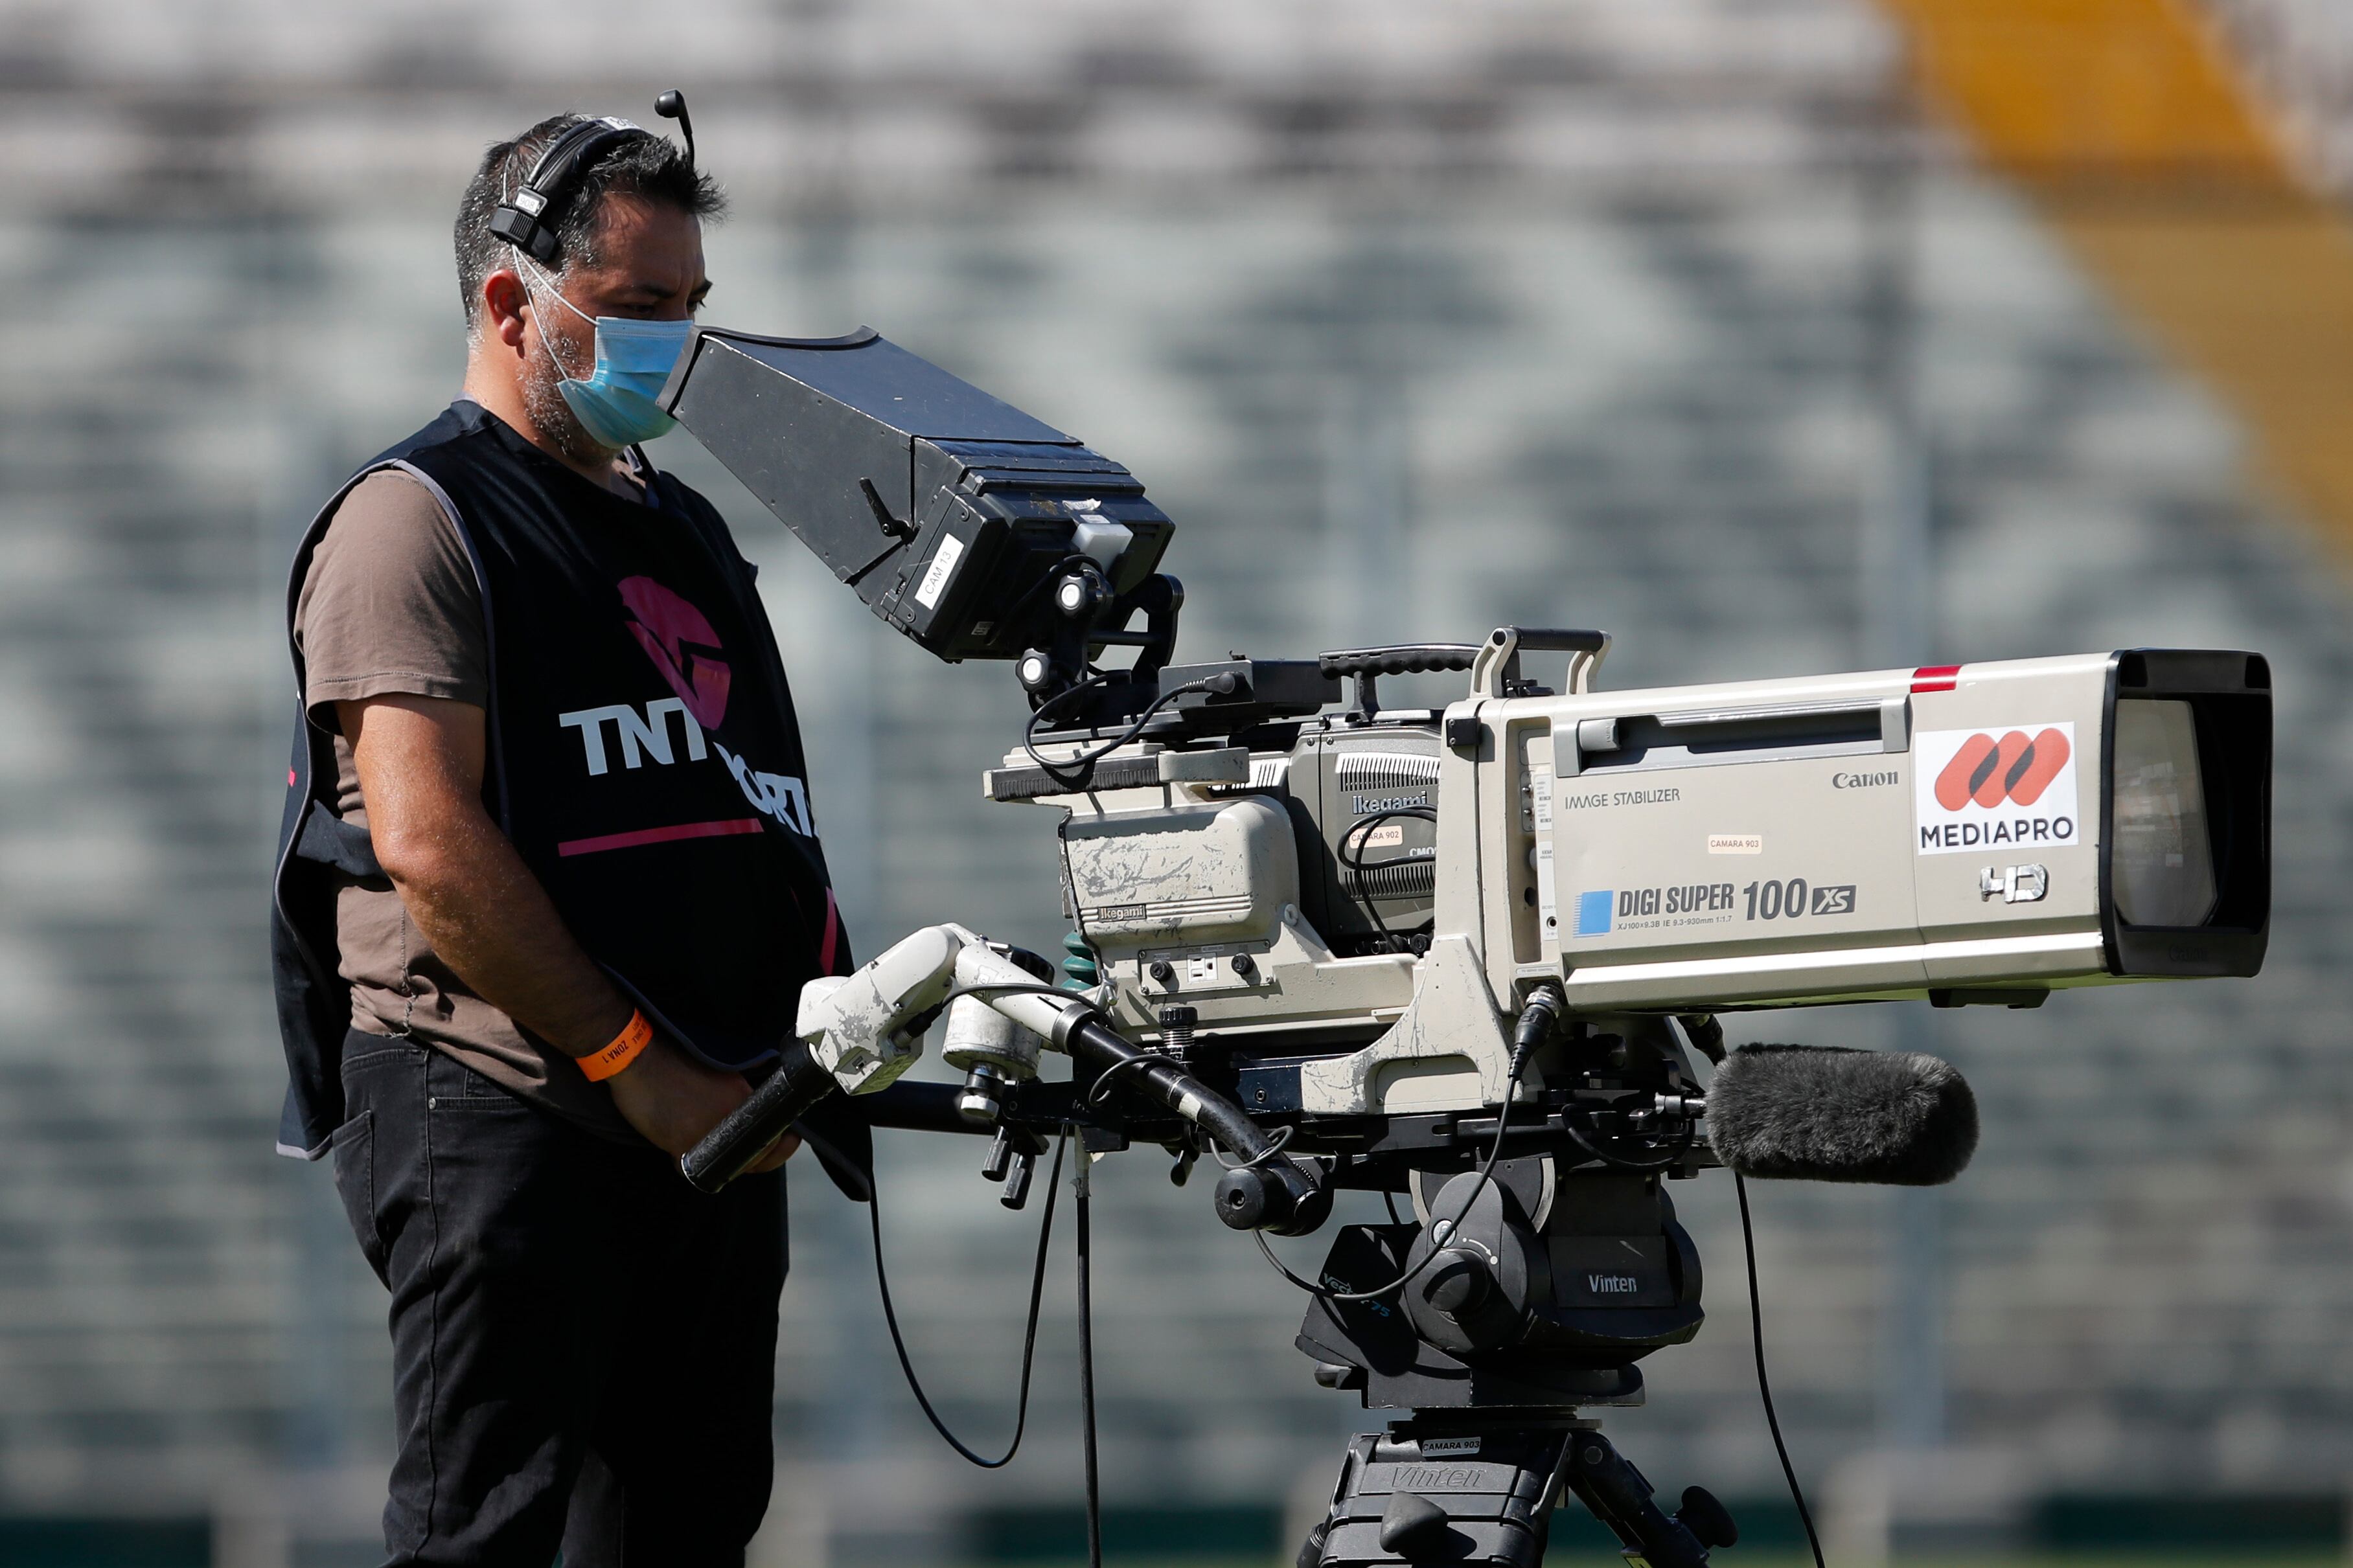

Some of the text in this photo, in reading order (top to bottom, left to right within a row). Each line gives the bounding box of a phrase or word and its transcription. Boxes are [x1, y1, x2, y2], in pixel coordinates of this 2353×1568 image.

[925, 551, 951, 594] CAM 13
[559, 697, 707, 776] TNT
[1833, 771, 1899, 789] Canon
[1565, 788, 1680, 810] IMAGE STABILIZER
[1351, 832, 1384, 841] CAARA
[1921, 816, 2074, 848] MEDIAPRO
[1409, 846, 1437, 856] CMO
[1710, 839, 1759, 848] CAMARA 903
[1980, 863, 2049, 903] HD
[1619, 878, 1852, 921] DIGI SUPER 100 XS
[1101, 905, 1143, 920] Ikegami
[1673, 917, 1714, 926] 9.3-930mm
[608, 1040, 629, 1060] ZONA
[1588, 1275, 1637, 1293] Vinten
[1371, 1301, 1390, 1317] 75
[1423, 1440, 1480, 1451] CAMARA 903
[1392, 1466, 1487, 1488] Vinten
